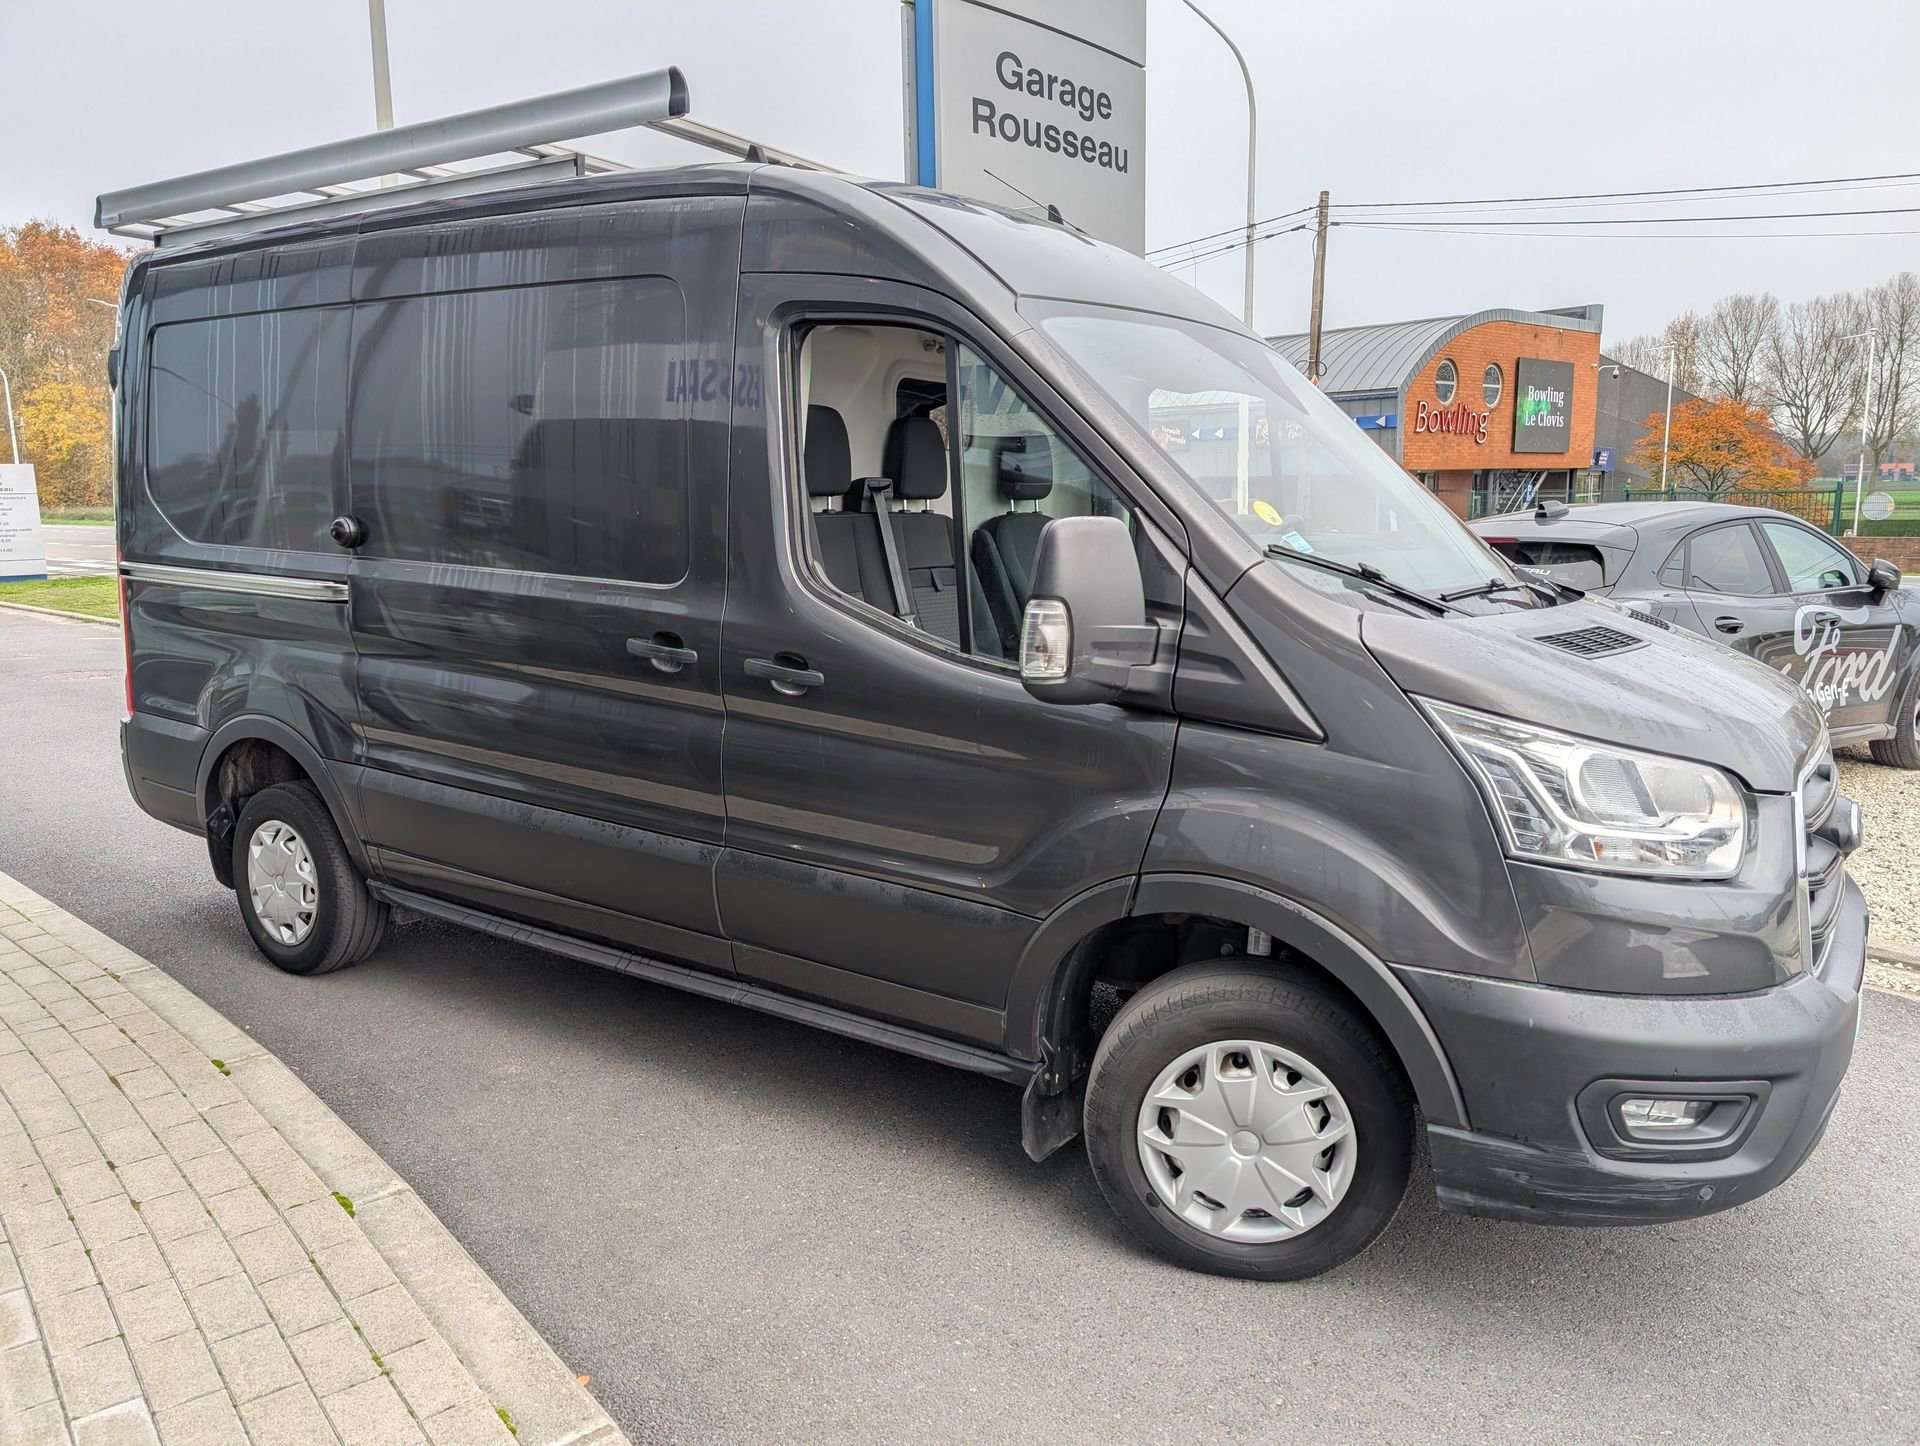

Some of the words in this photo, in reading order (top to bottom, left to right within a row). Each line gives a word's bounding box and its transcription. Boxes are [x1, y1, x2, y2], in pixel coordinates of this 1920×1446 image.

[995, 51, 1113, 122] Garage
[972, 96, 1129, 174] Rousseau
[1528, 385, 1565, 407] Bowling
[1416, 401, 1490, 444] Bowling
[1525, 410, 1537, 427] Le
[1537, 411, 1565, 428] Clovis
[1781, 604, 1902, 710] Ford
[1815, 677, 1850, 702] Gen-E
